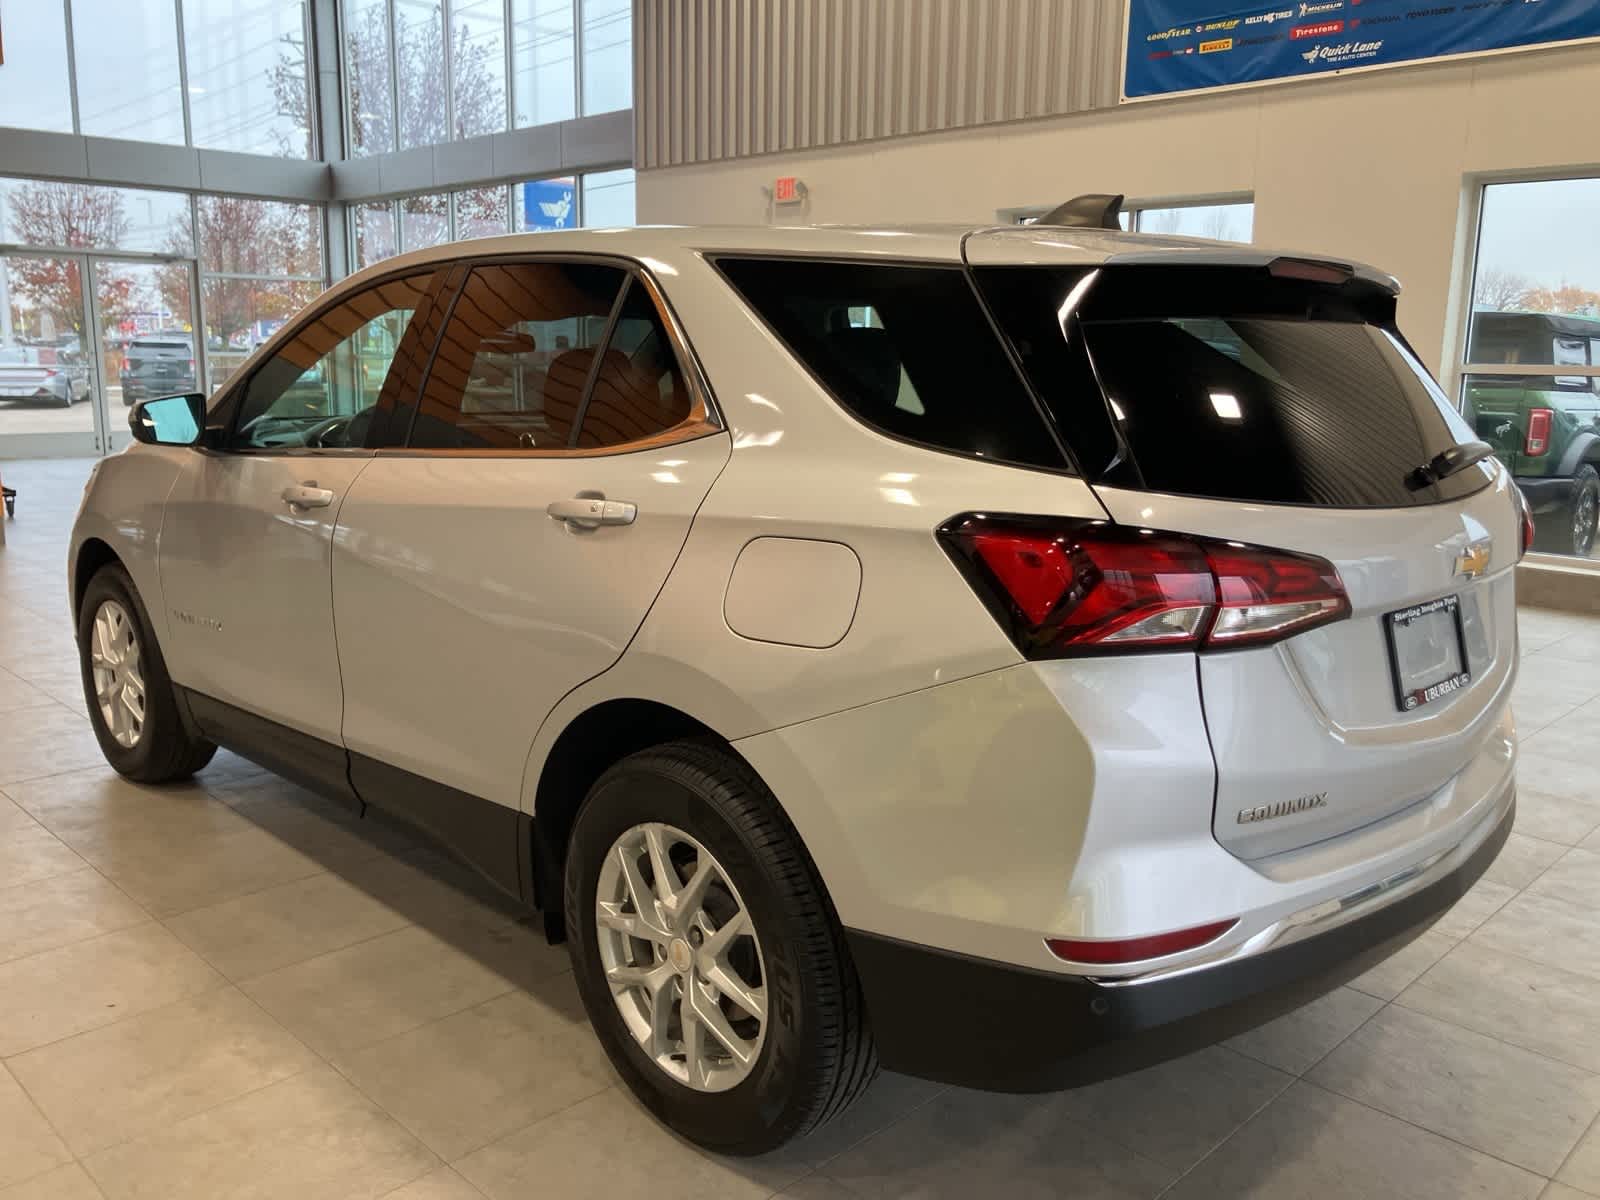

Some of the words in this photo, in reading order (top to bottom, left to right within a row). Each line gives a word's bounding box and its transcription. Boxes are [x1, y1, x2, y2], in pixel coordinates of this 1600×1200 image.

[1307, 1, 1343, 11] MICHELIN
[1205, 20, 1240, 30] DUNLOP
[1245, 15, 1265, 25] KELLY
[1275, 10, 1293, 20] TIRES
[1147, 28, 1192, 41] GOODYEAR
[1295, 23, 1339, 38] Firestone
[1320, 43, 1352, 58] Quick
[1352, 42, 1382, 54] Lane
[776, 178, 797, 200] EXIT
[1237, 792, 1328, 824] EQUINOX
